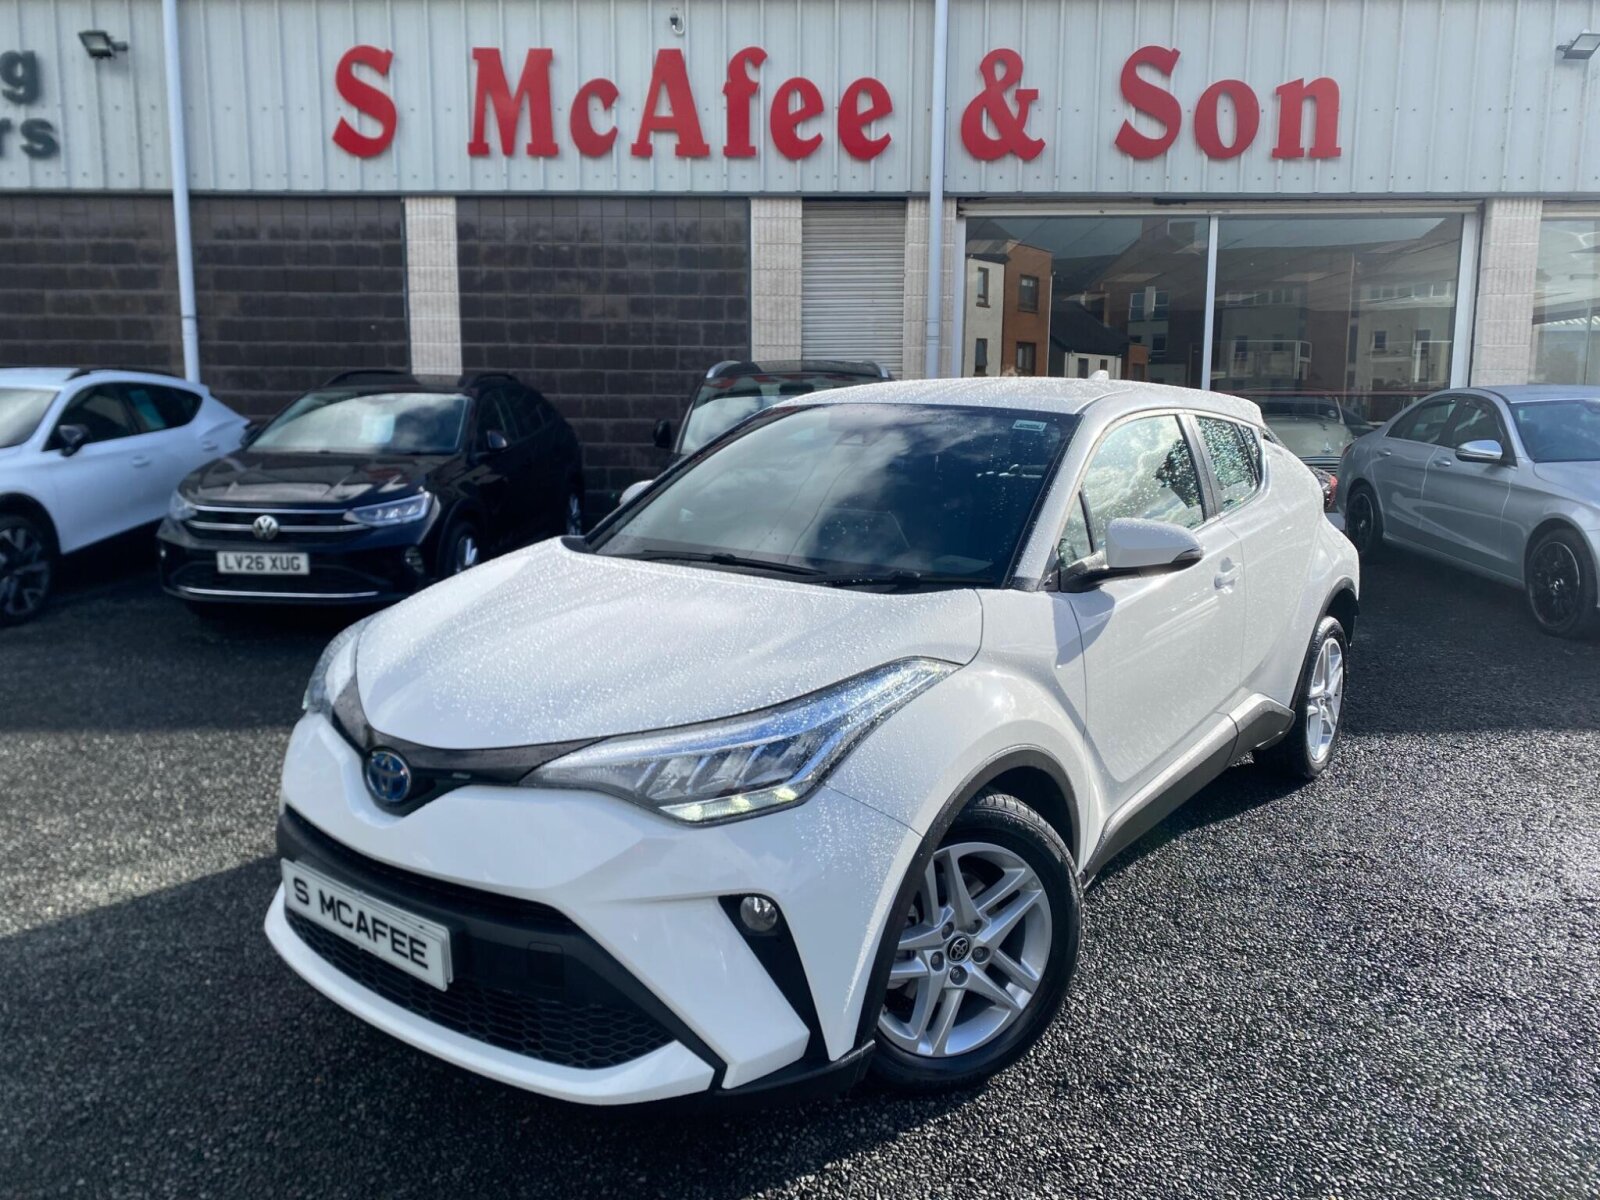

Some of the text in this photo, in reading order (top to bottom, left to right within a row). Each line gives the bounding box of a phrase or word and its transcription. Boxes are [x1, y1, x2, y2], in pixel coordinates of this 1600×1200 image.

[332, 45, 1342, 162] S McAfee & Son
[223, 555, 301, 571] LV26 XUG
[293, 877, 429, 970] S MCAFEE
